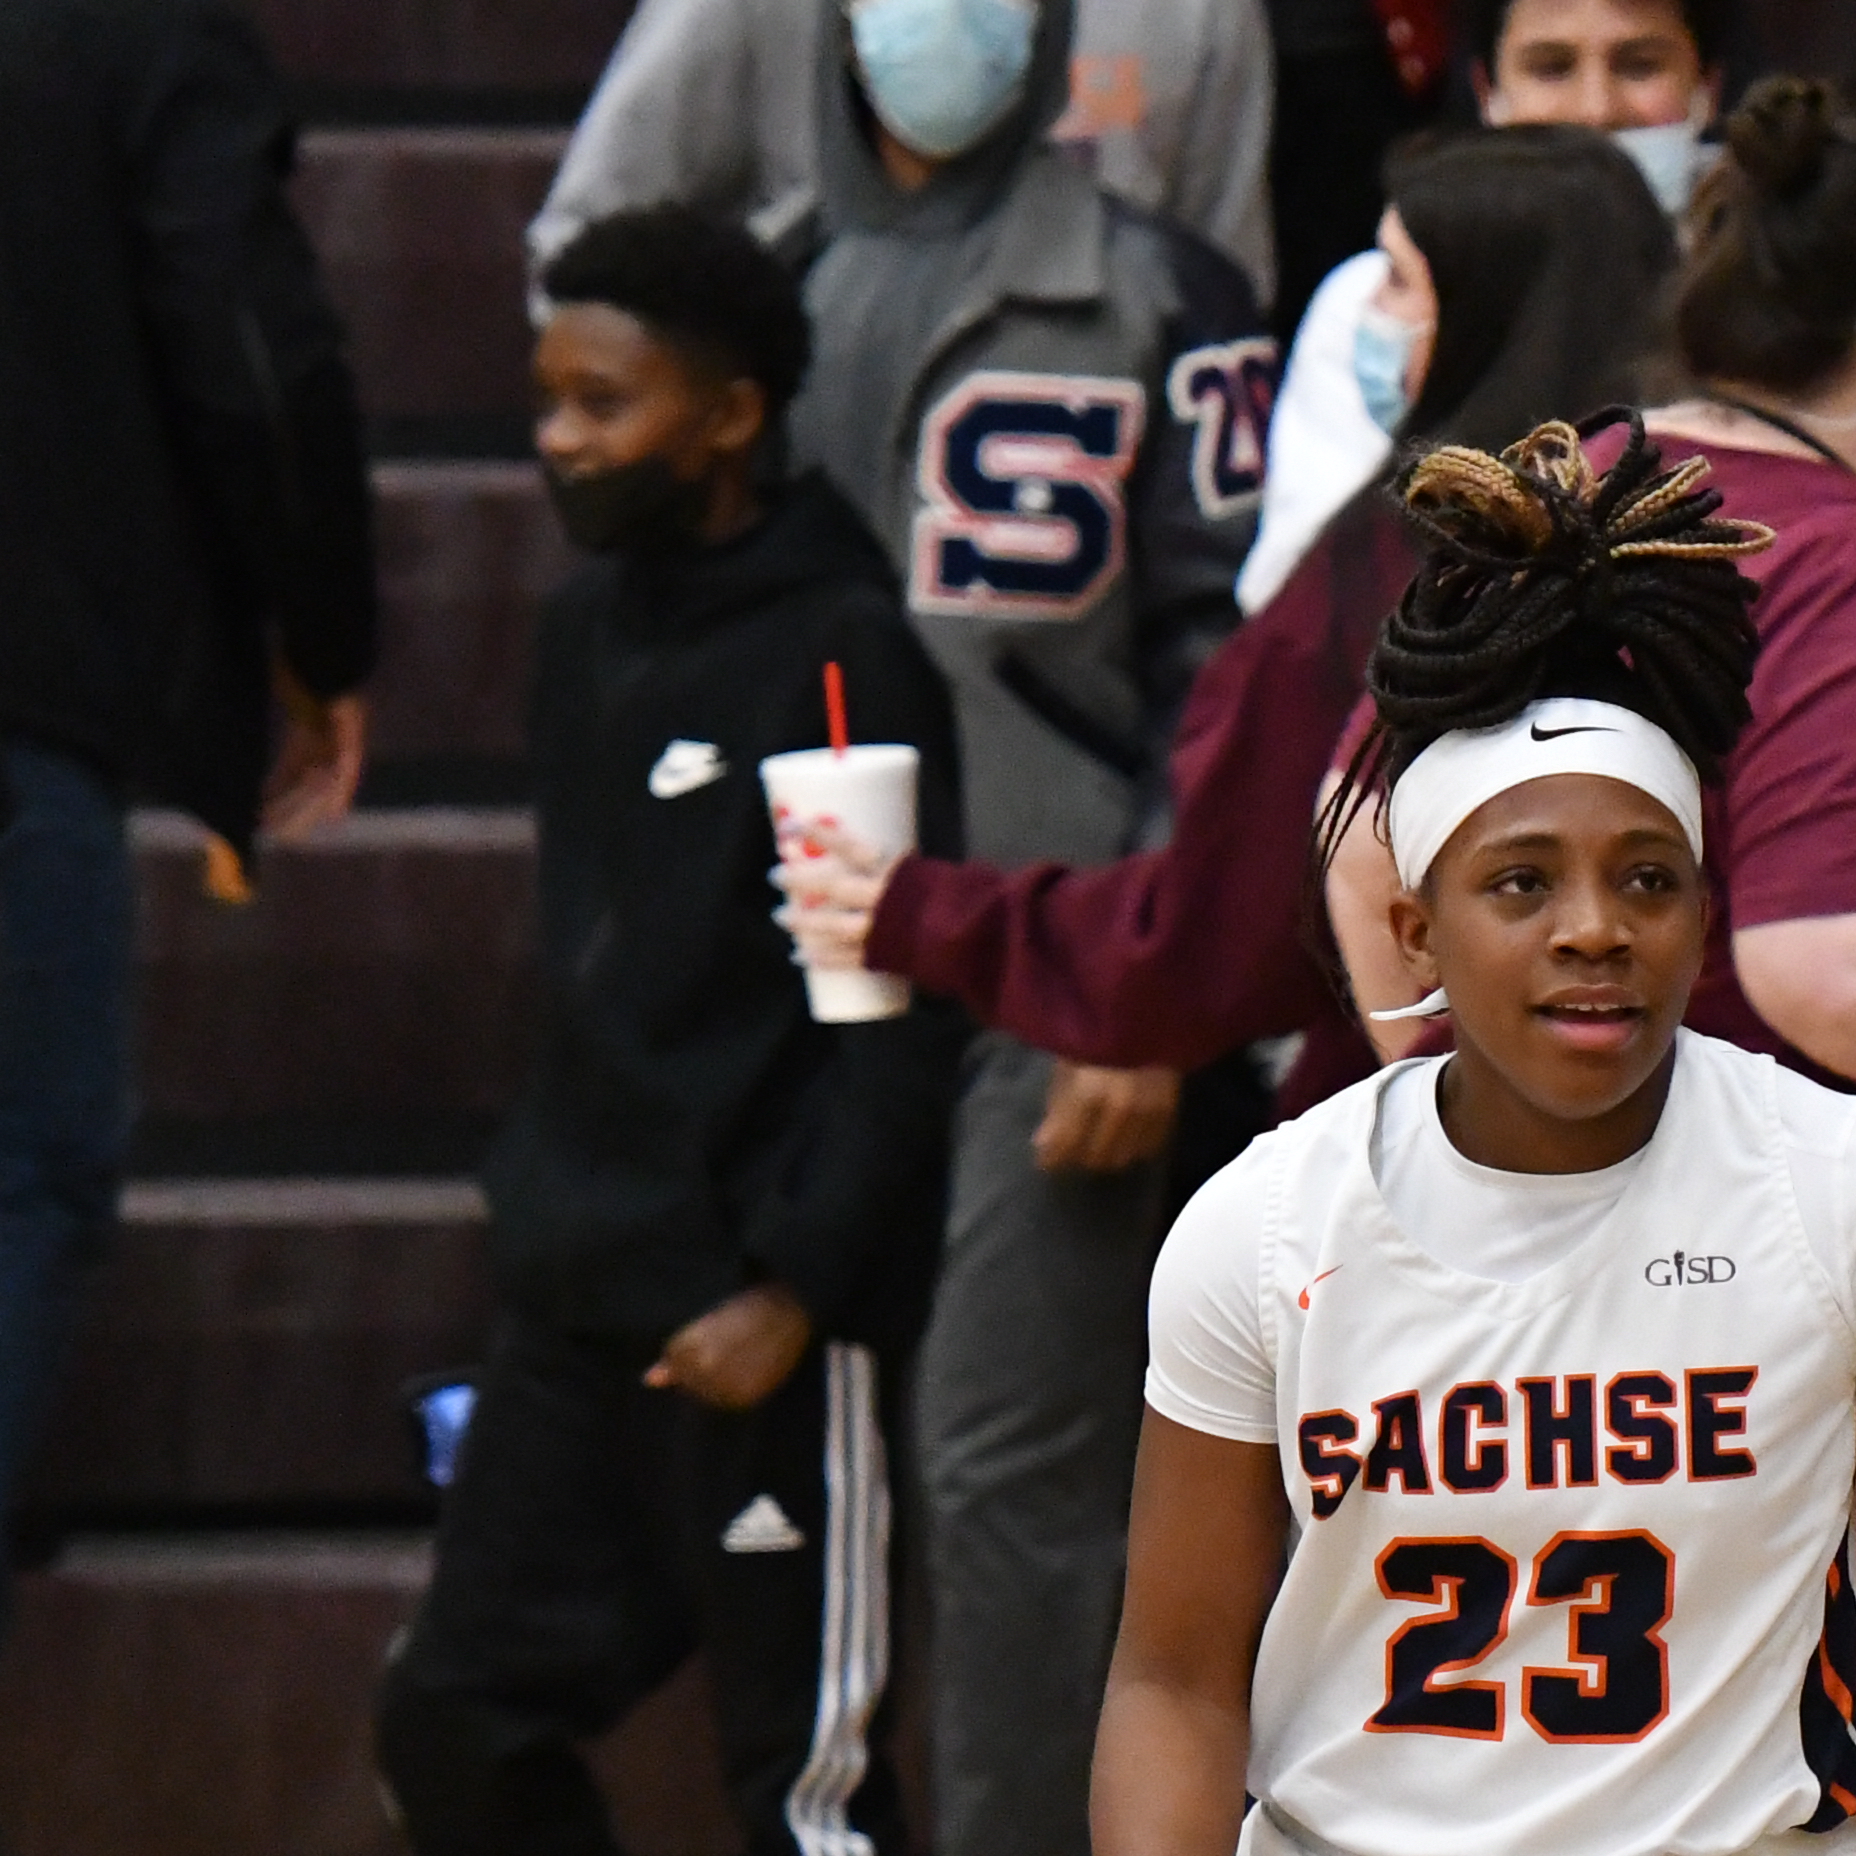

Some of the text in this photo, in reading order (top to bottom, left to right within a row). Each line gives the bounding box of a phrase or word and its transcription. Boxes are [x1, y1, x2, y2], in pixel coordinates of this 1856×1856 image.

[908, 370, 1147, 619] S
[1297, 1364, 1760, 1521] SACHSE
[1361, 1527, 1678, 1746] 23
